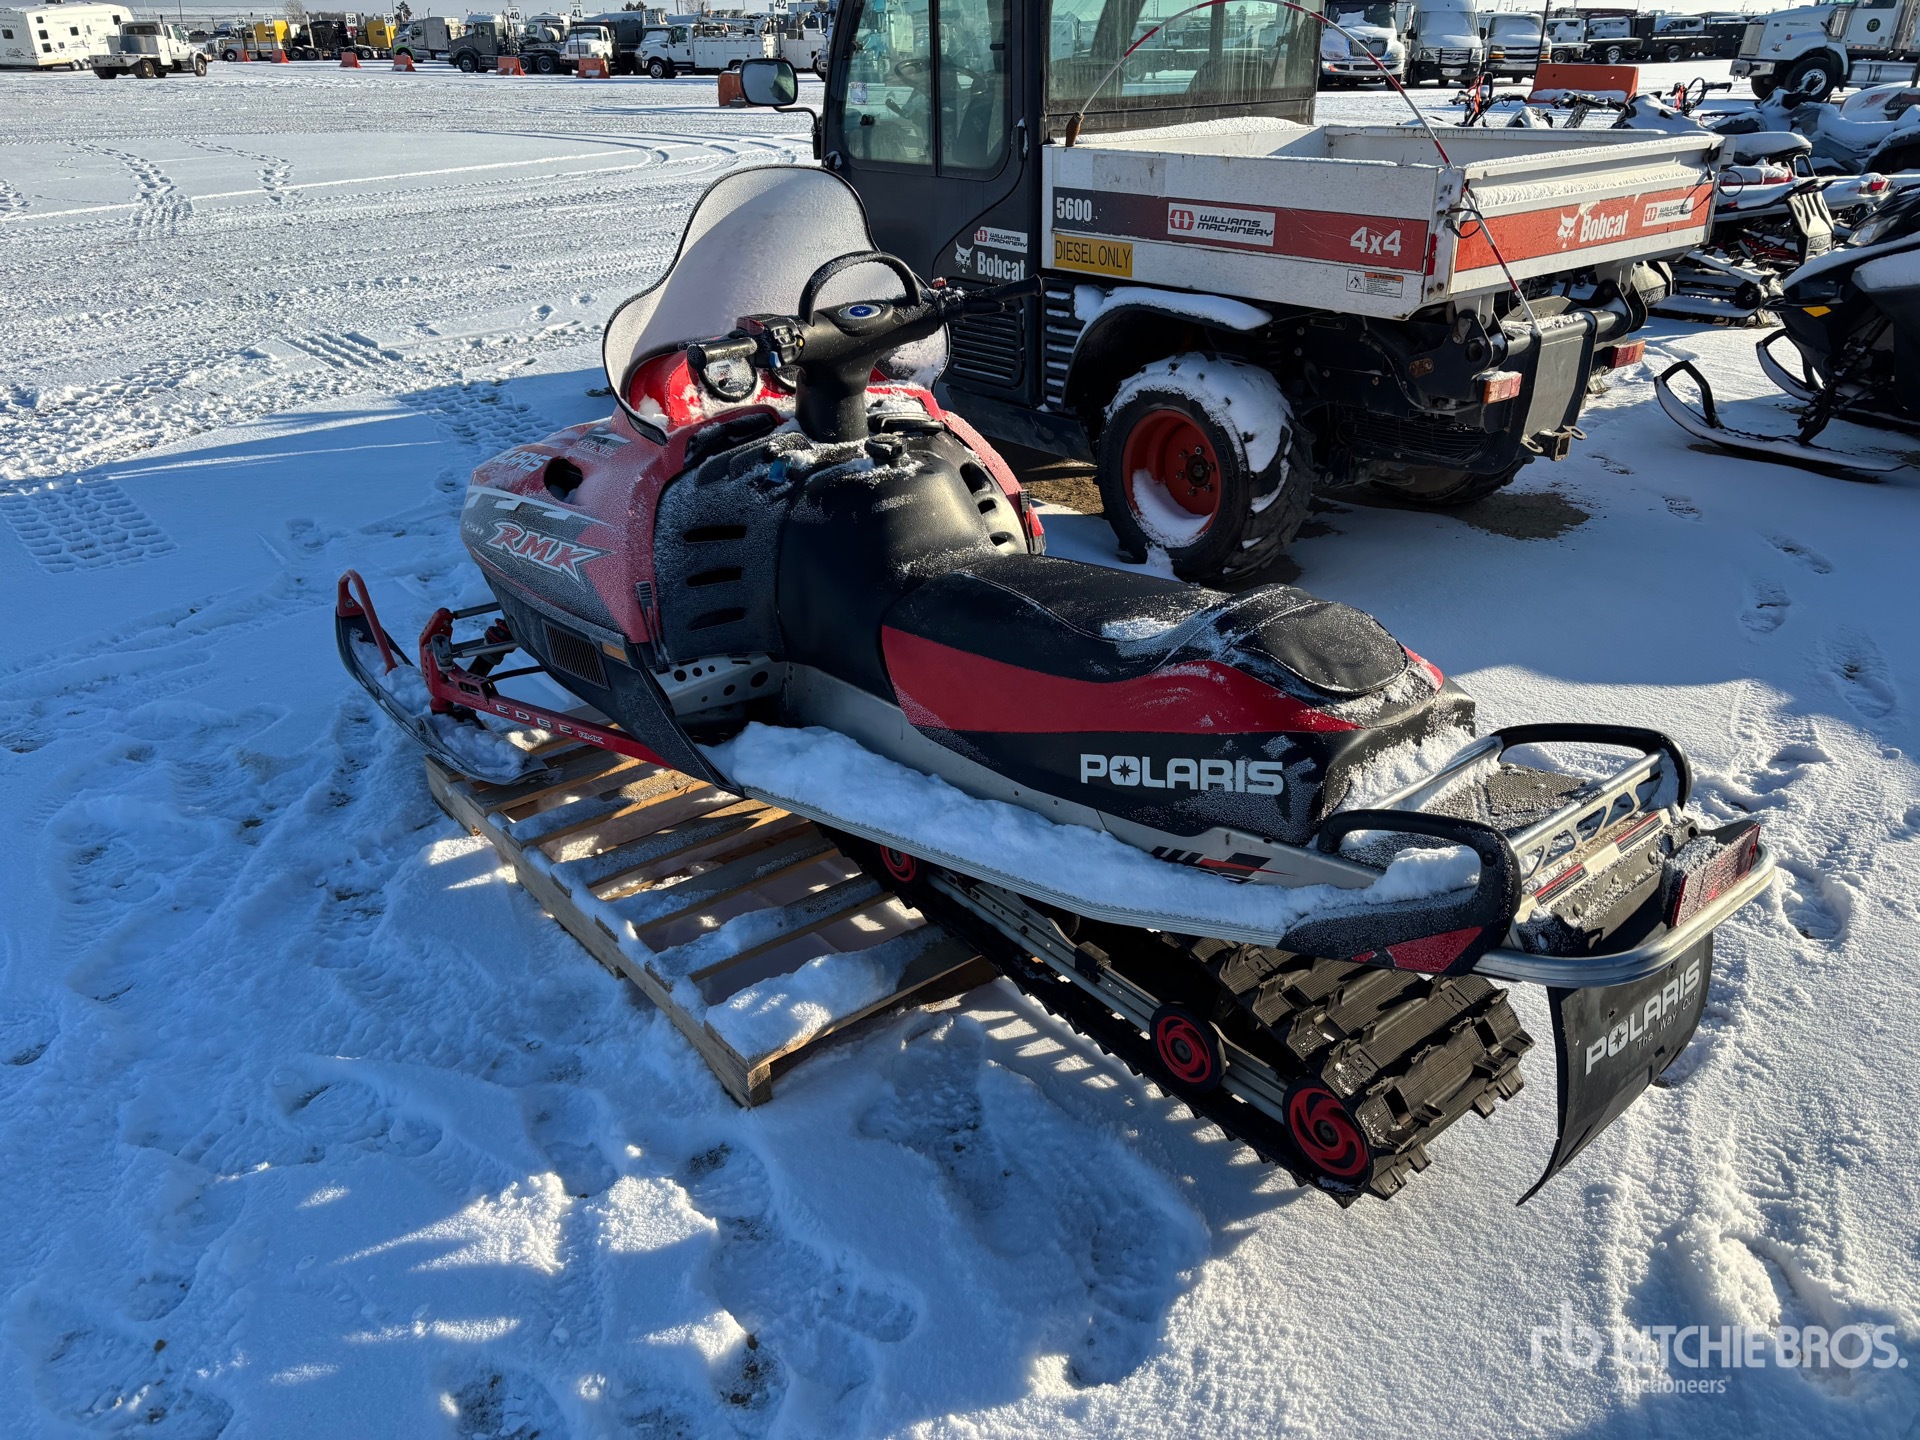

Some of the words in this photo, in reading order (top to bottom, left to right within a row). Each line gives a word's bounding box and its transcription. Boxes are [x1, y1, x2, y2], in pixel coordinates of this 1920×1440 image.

[510, 11, 520, 20] 40
[572, 9, 582, 18] 41
[775, 0, 787, 9] 42
[347, 16, 356, 24] 38
[385, 16, 394, 24] 39
[1056, 196, 1092, 222] 5600
[1199, 214, 1261, 228] WILLIAMS
[990, 232, 1021, 242] WILLIAMS
[1197, 221, 1274, 237] MACHINERY
[1579, 209, 1629, 243] Bobcat
[988, 237, 1028, 248] MACHINERY
[1055, 240, 1095, 265] DIESEL
[1098, 245, 1132, 269] ONLY
[1350, 226, 1402, 257] 4x4
[977, 251, 1026, 281] Bobcat
[485, 522, 601, 583] RMK
[495, 704, 573, 735] EDGE
[1080, 753, 1284, 796] POLARIS
[1585, 958, 1700, 1076] POLARIS
[1636, 1032, 1654, 1050] The
[1659, 1008, 1678, 1032] Way
[1682, 991, 1697, 1010] Out
